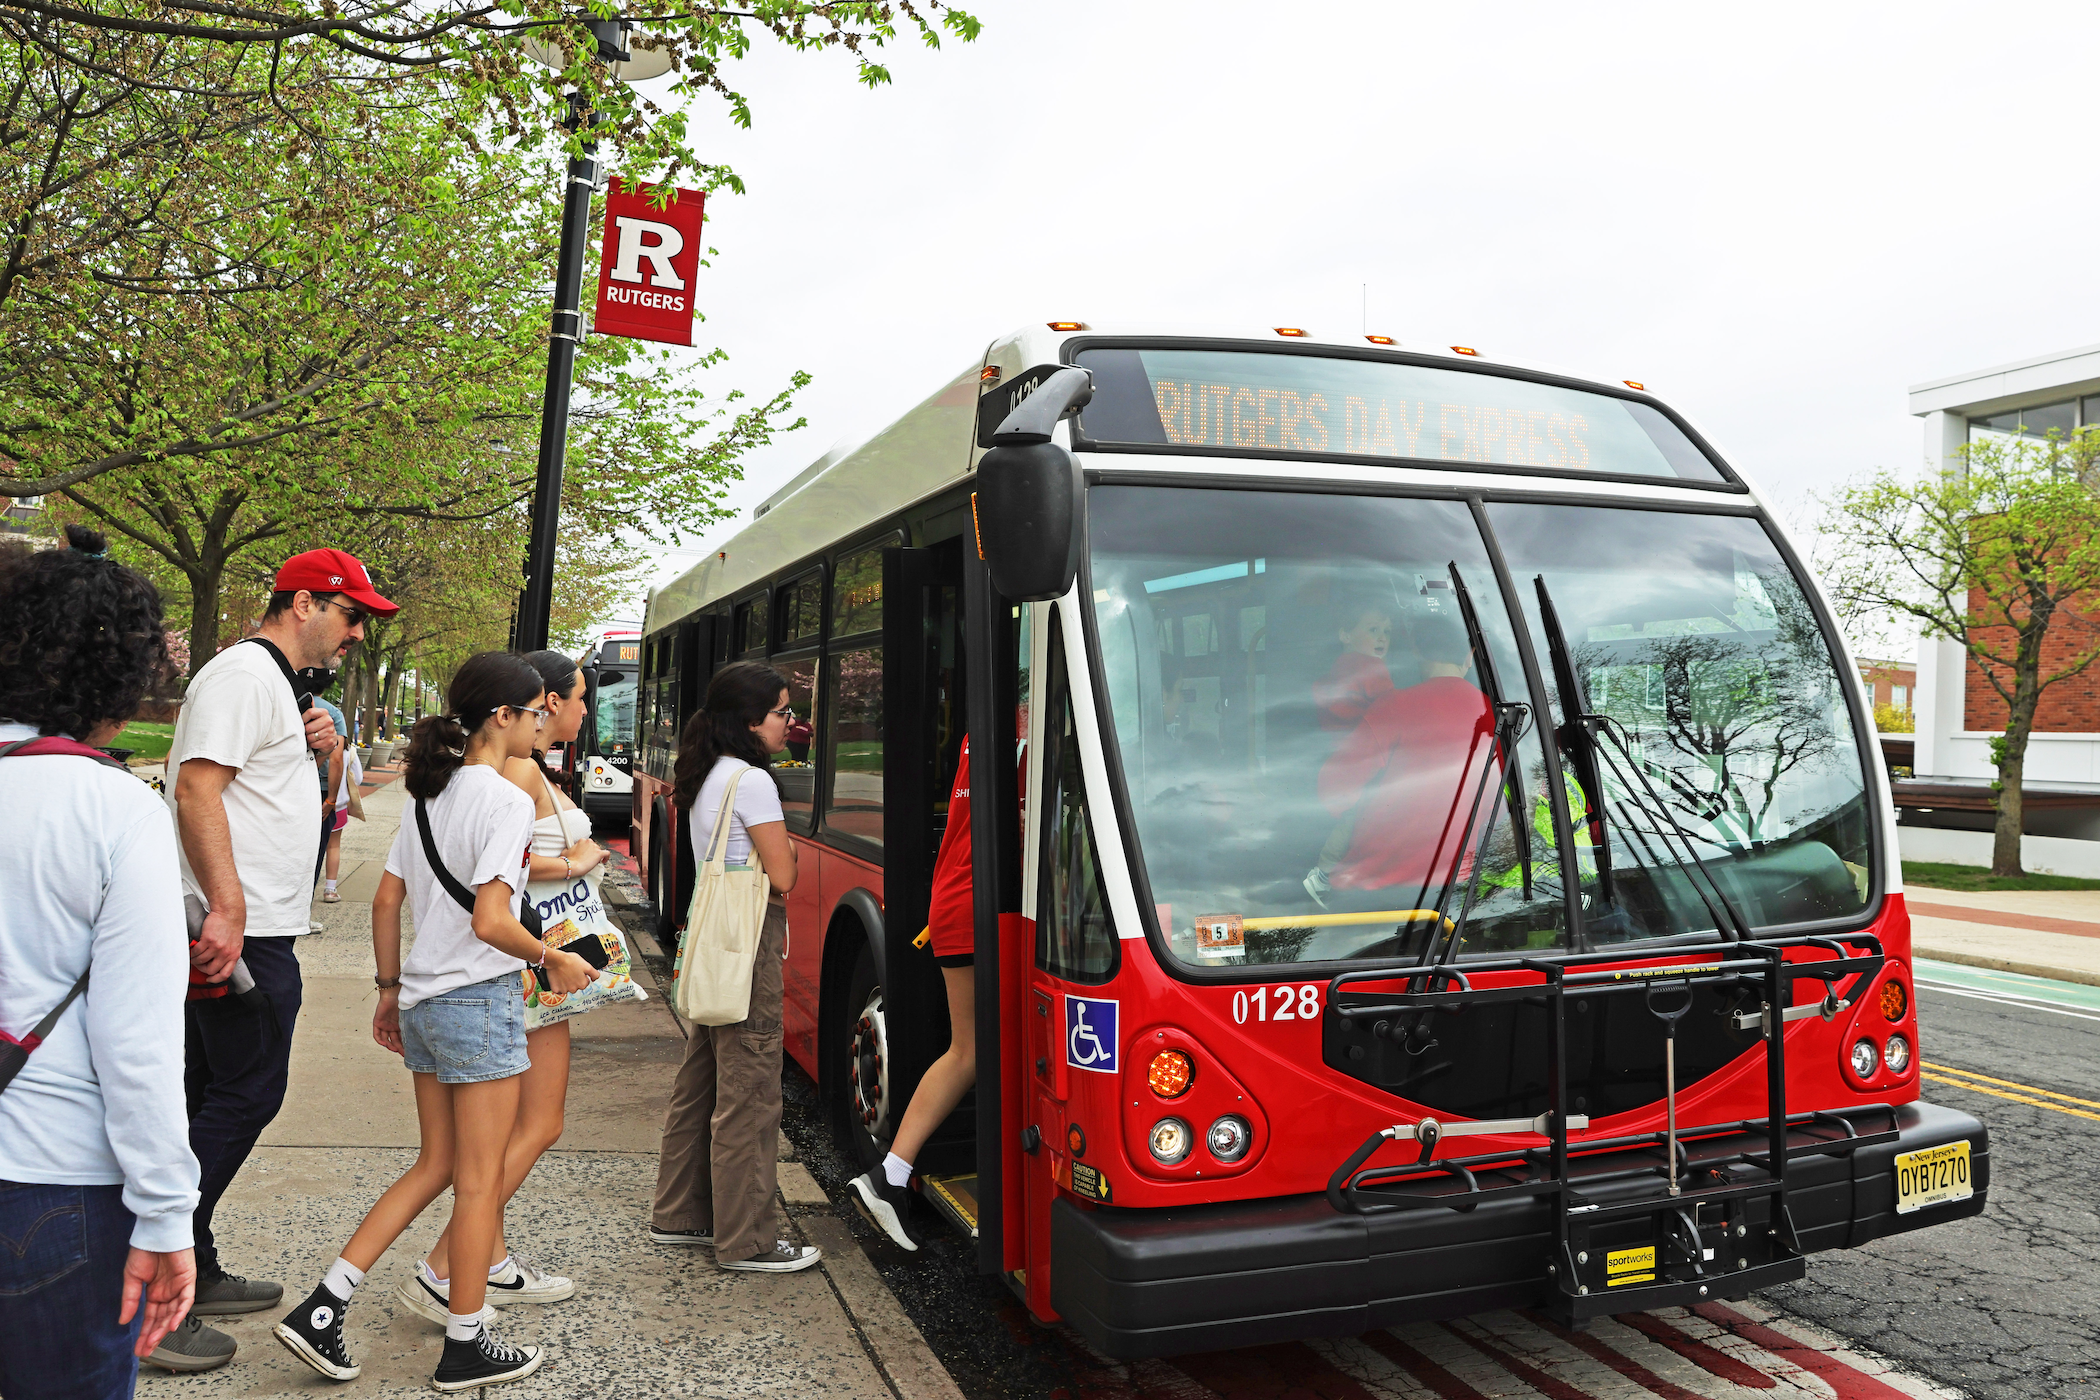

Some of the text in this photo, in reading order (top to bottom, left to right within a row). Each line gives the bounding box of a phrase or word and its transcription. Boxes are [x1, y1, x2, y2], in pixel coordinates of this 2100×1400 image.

[610, 215, 685, 291] R
[606, 285, 685, 312] RUTGERS
[1157, 381, 1589, 469] RUTGERS DAY EXPRESS
[620, 646, 639, 660] RUT
[607, 756, 628, 765] 4200
[955, 788, 970, 798] SHI
[523, 878, 591, 921] oma
[1215, 926, 1222, 940] 5
[1232, 985, 1320, 1025] 0128
[1914, 1148, 1952, 1162] New Jersey
[1073, 1162, 1095, 1176] CAUTION
[1924, 1193, 1947, 1203] OMNIBUS
[1608, 1252, 1653, 1267] sportworks
